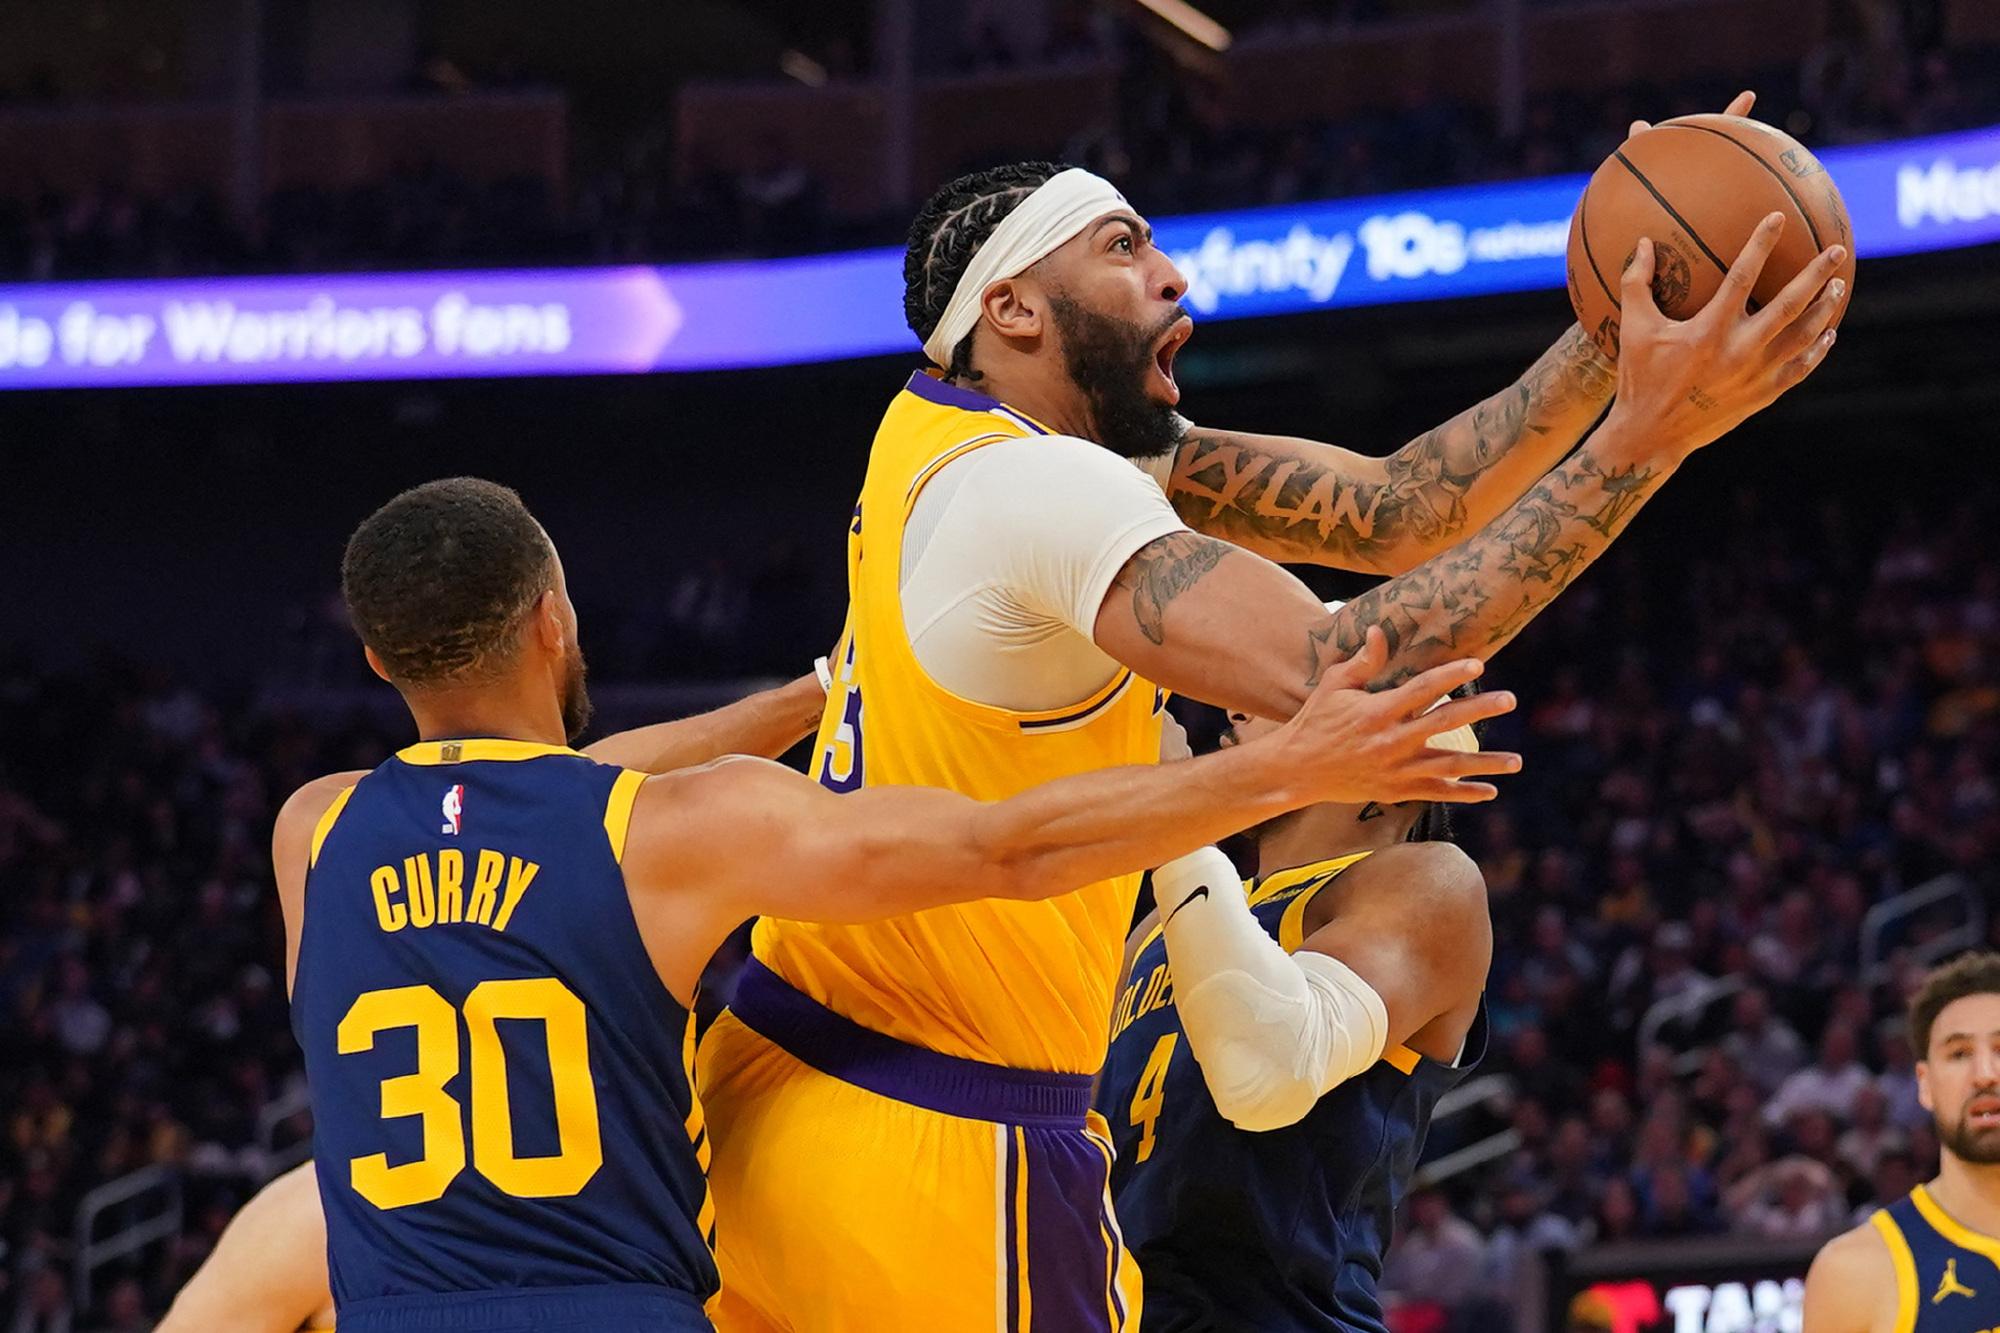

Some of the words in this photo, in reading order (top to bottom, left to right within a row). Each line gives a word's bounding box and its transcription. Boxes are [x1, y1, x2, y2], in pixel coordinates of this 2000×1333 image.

[60, 302, 154, 365] for
[164, 294, 426, 363] Warriors
[433, 292, 571, 356] fans
[1166, 440, 1390, 544] KYLAN
[370, 849, 540, 933] CURRY
[337, 977, 603, 1211] 30
[1130, 1032, 1178, 1164] 4
